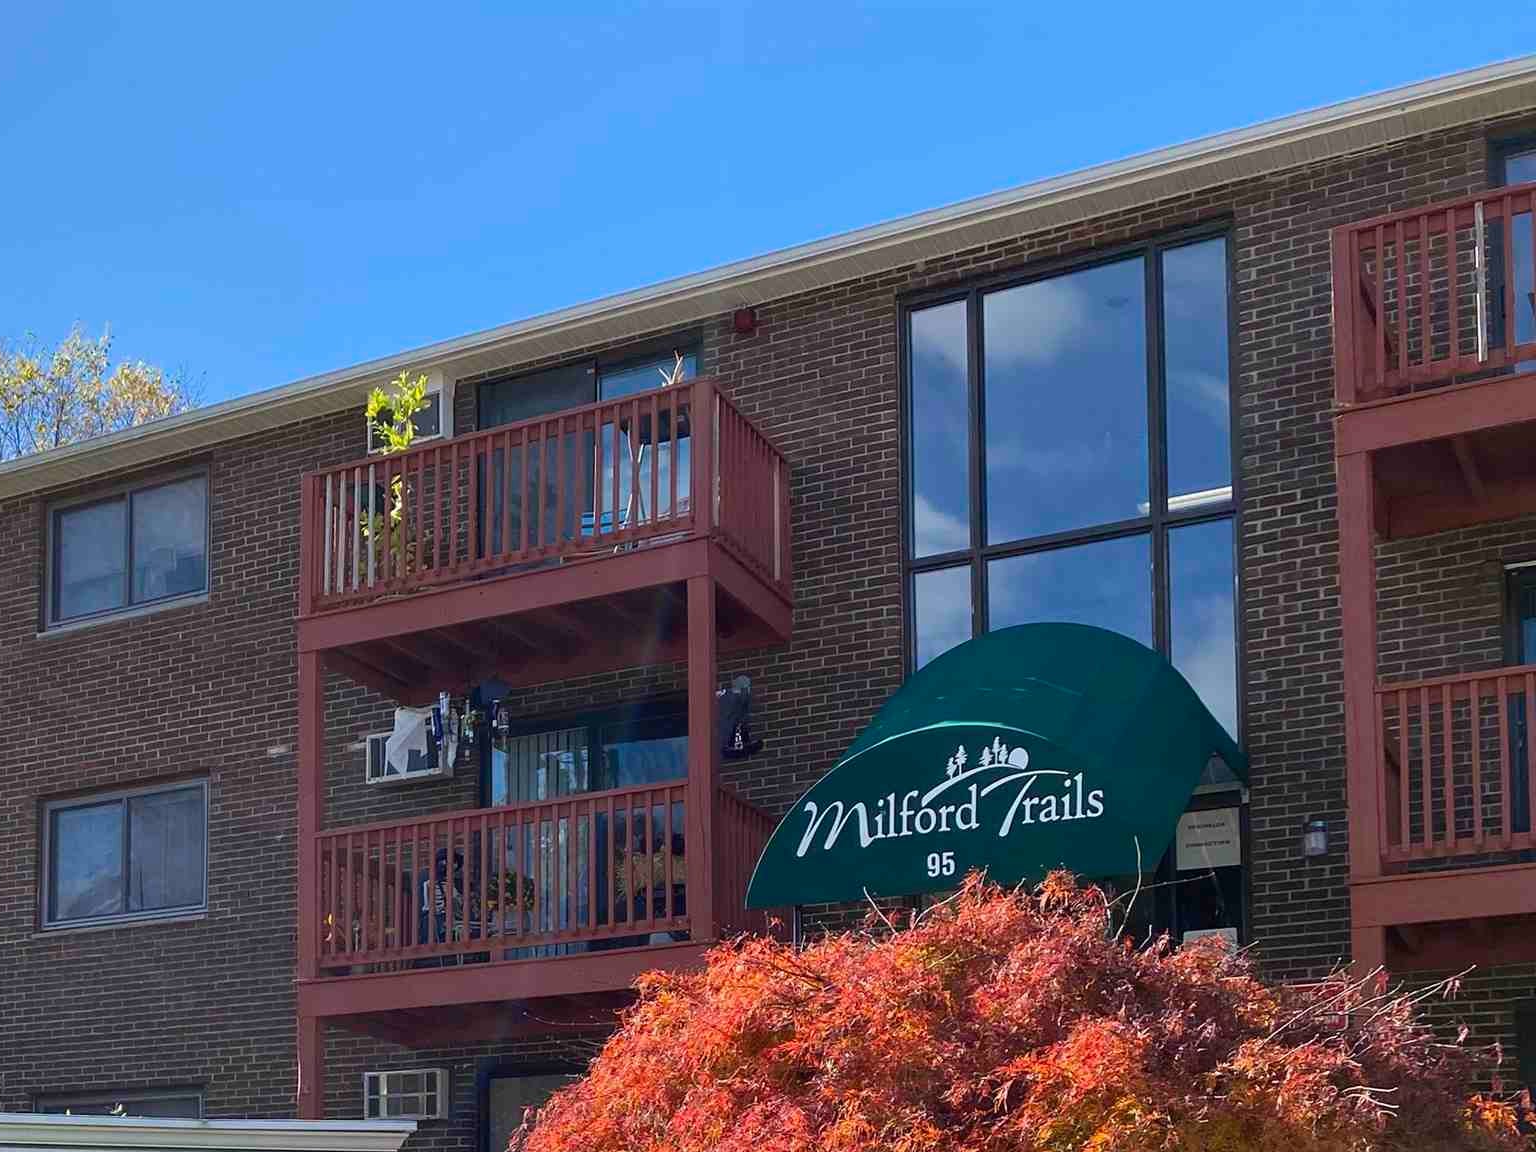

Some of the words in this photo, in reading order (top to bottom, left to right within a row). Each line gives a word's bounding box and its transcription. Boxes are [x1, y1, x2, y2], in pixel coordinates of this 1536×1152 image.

[795, 780, 980, 858] Milford
[980, 769, 1105, 838] Trails
[926, 850, 956, 878] 95
